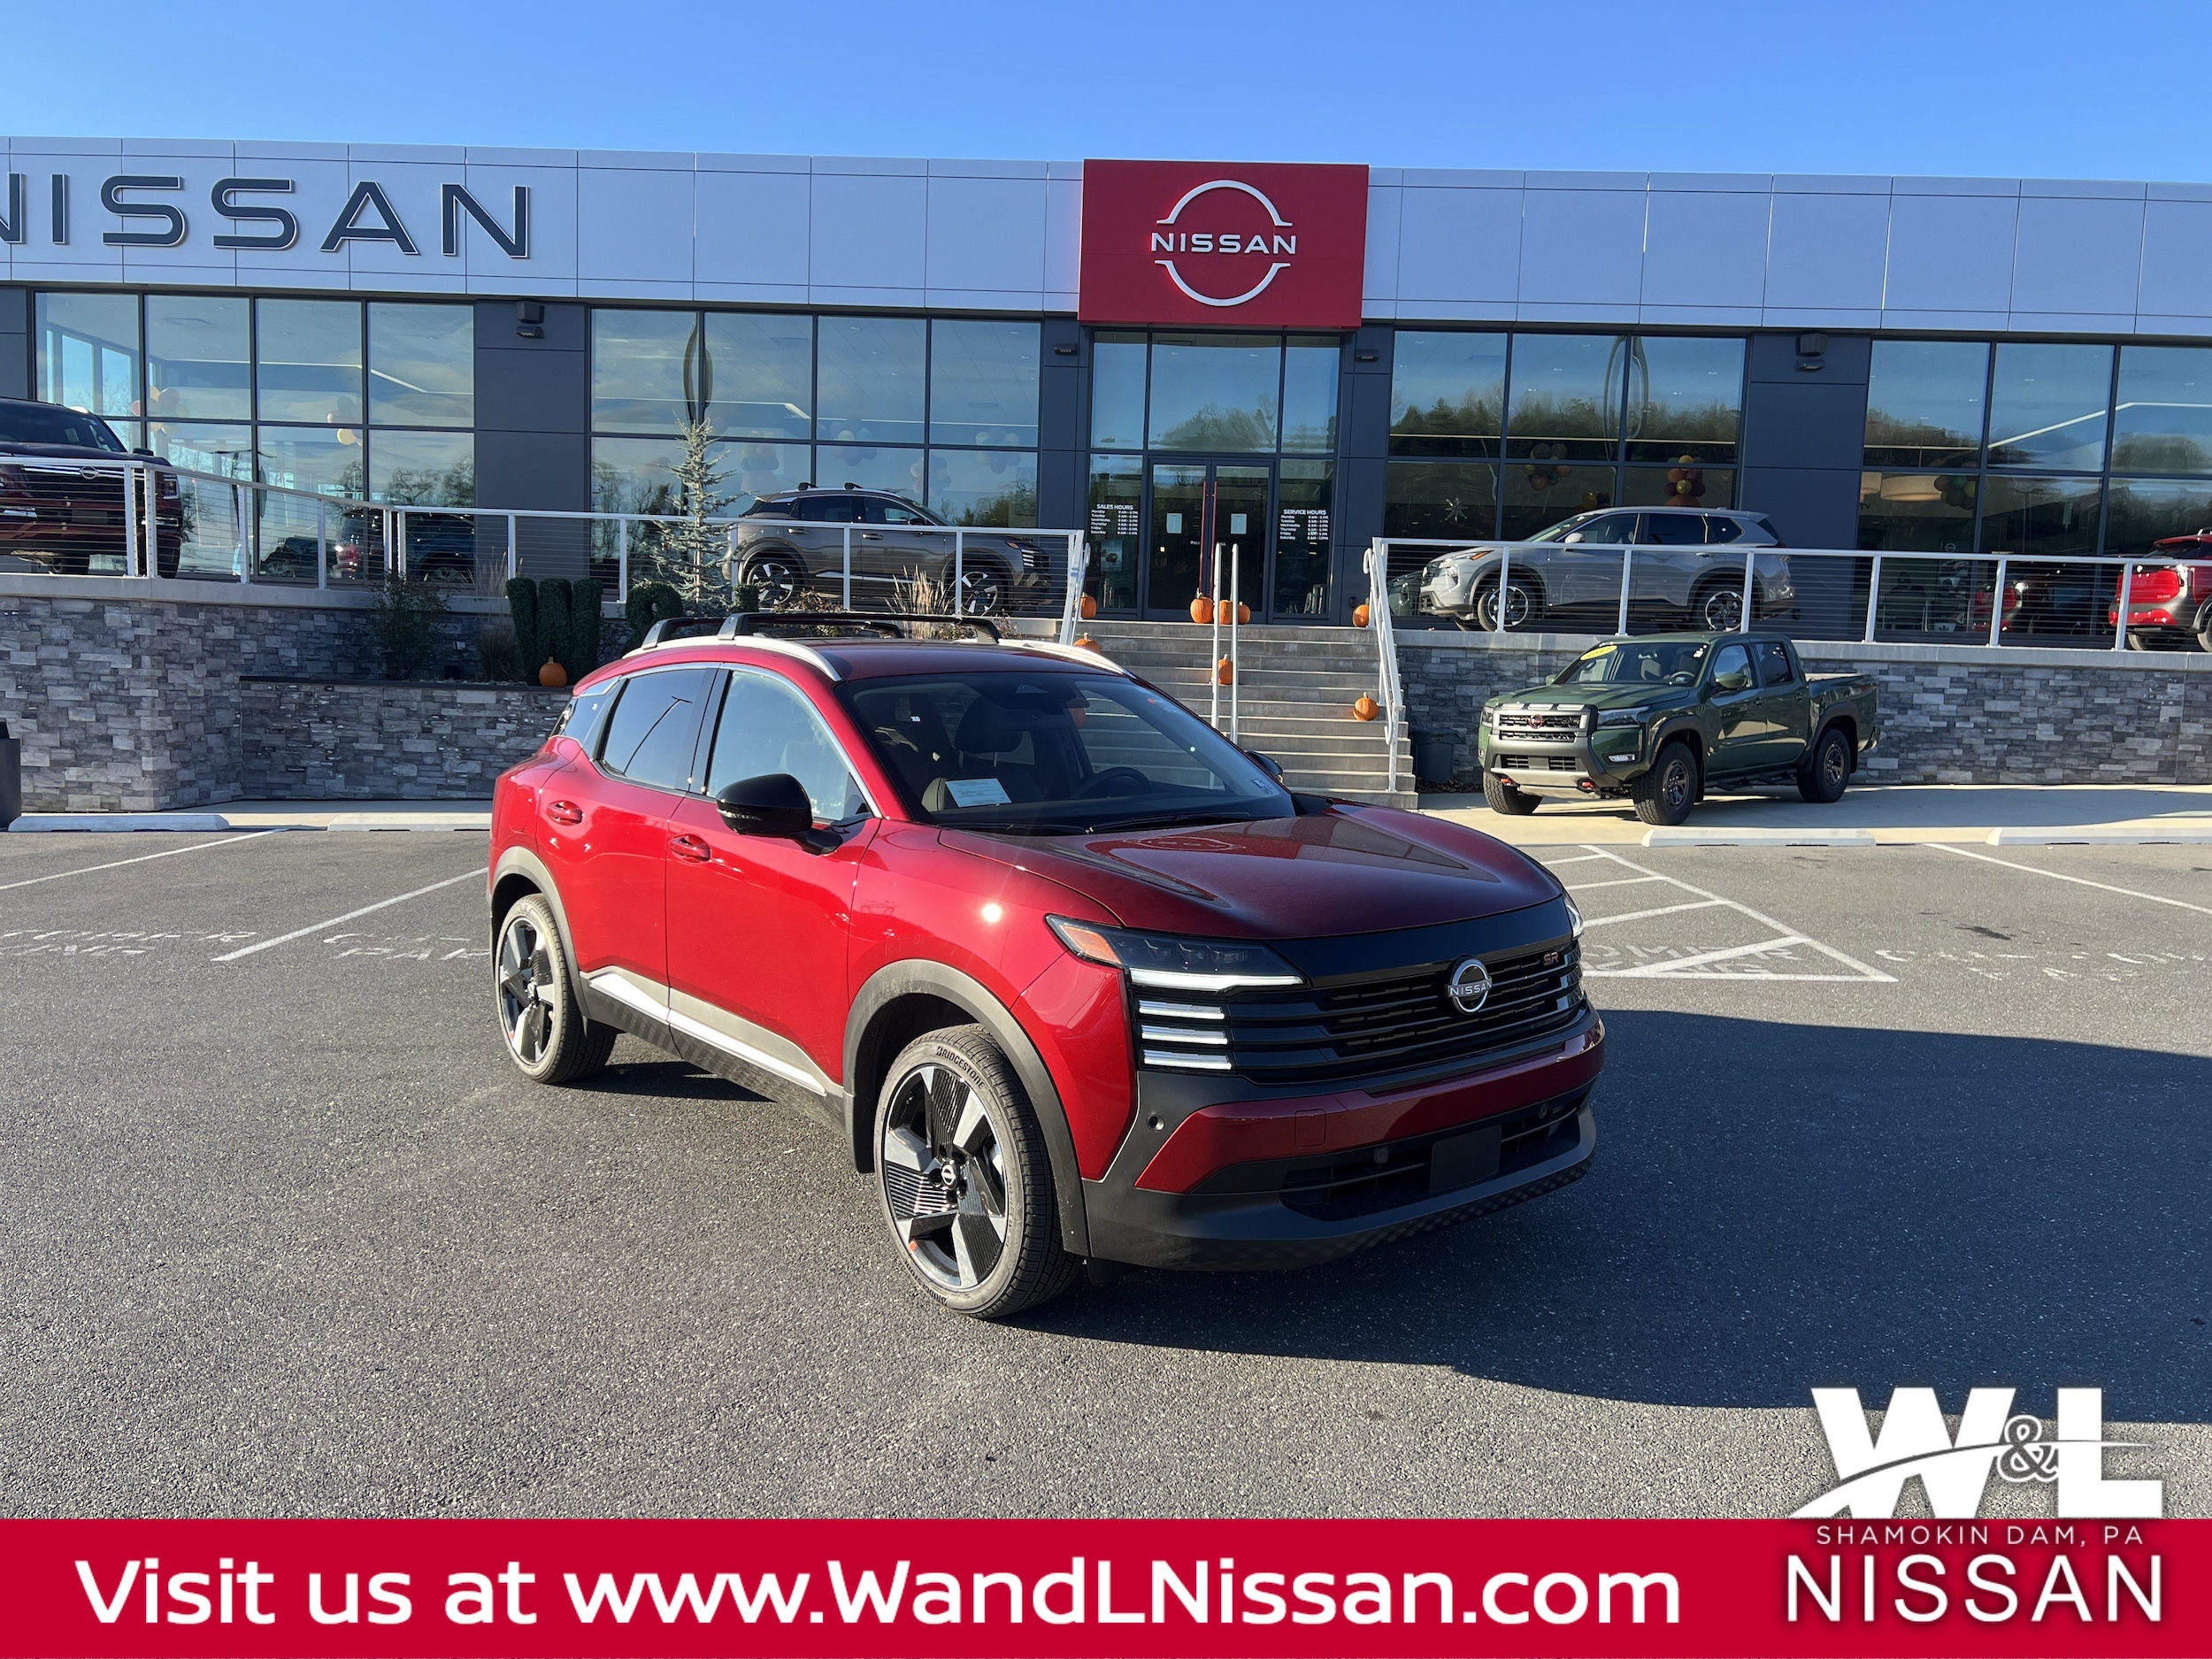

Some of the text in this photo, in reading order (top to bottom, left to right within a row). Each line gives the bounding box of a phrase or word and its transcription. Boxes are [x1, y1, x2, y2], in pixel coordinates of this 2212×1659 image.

[0, 173, 531, 258] ISSAN
[1152, 232, 1296, 255] NISSAN
[1543, 951, 1559, 966] SR
[1450, 981, 1493, 996] NISSAN
[935, 1046, 986, 1089] BRIDGESTONE
